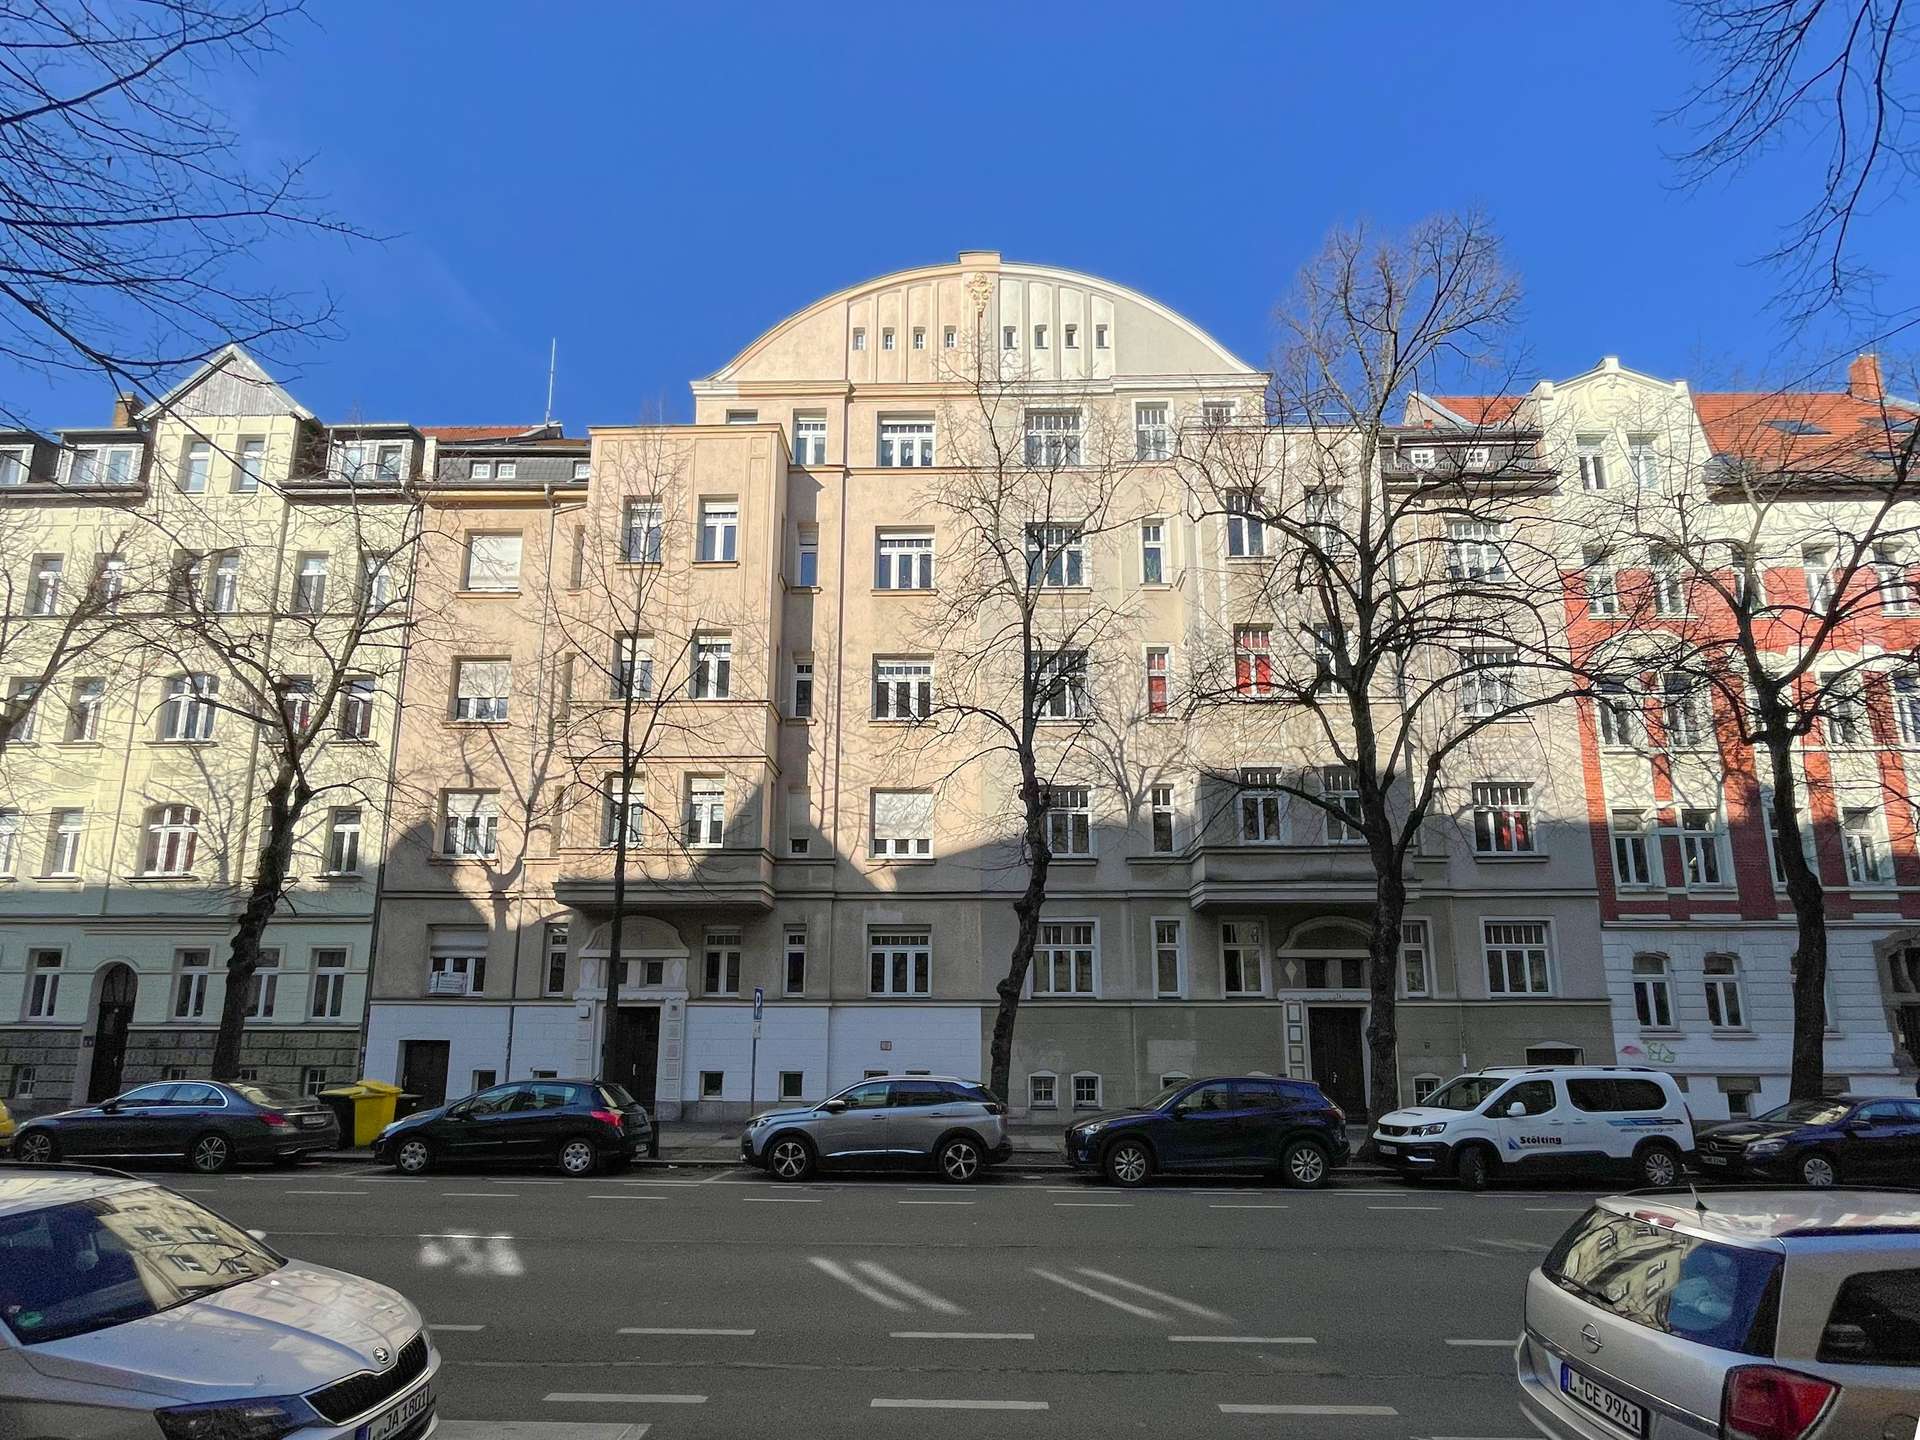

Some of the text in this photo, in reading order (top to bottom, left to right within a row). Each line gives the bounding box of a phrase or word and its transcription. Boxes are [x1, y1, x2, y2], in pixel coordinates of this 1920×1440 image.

[1519, 1136, 1562, 1145] Stölting
[1569, 1371, 1640, 1432] L CE 9961
[384, 1409, 399, 1433] JA
